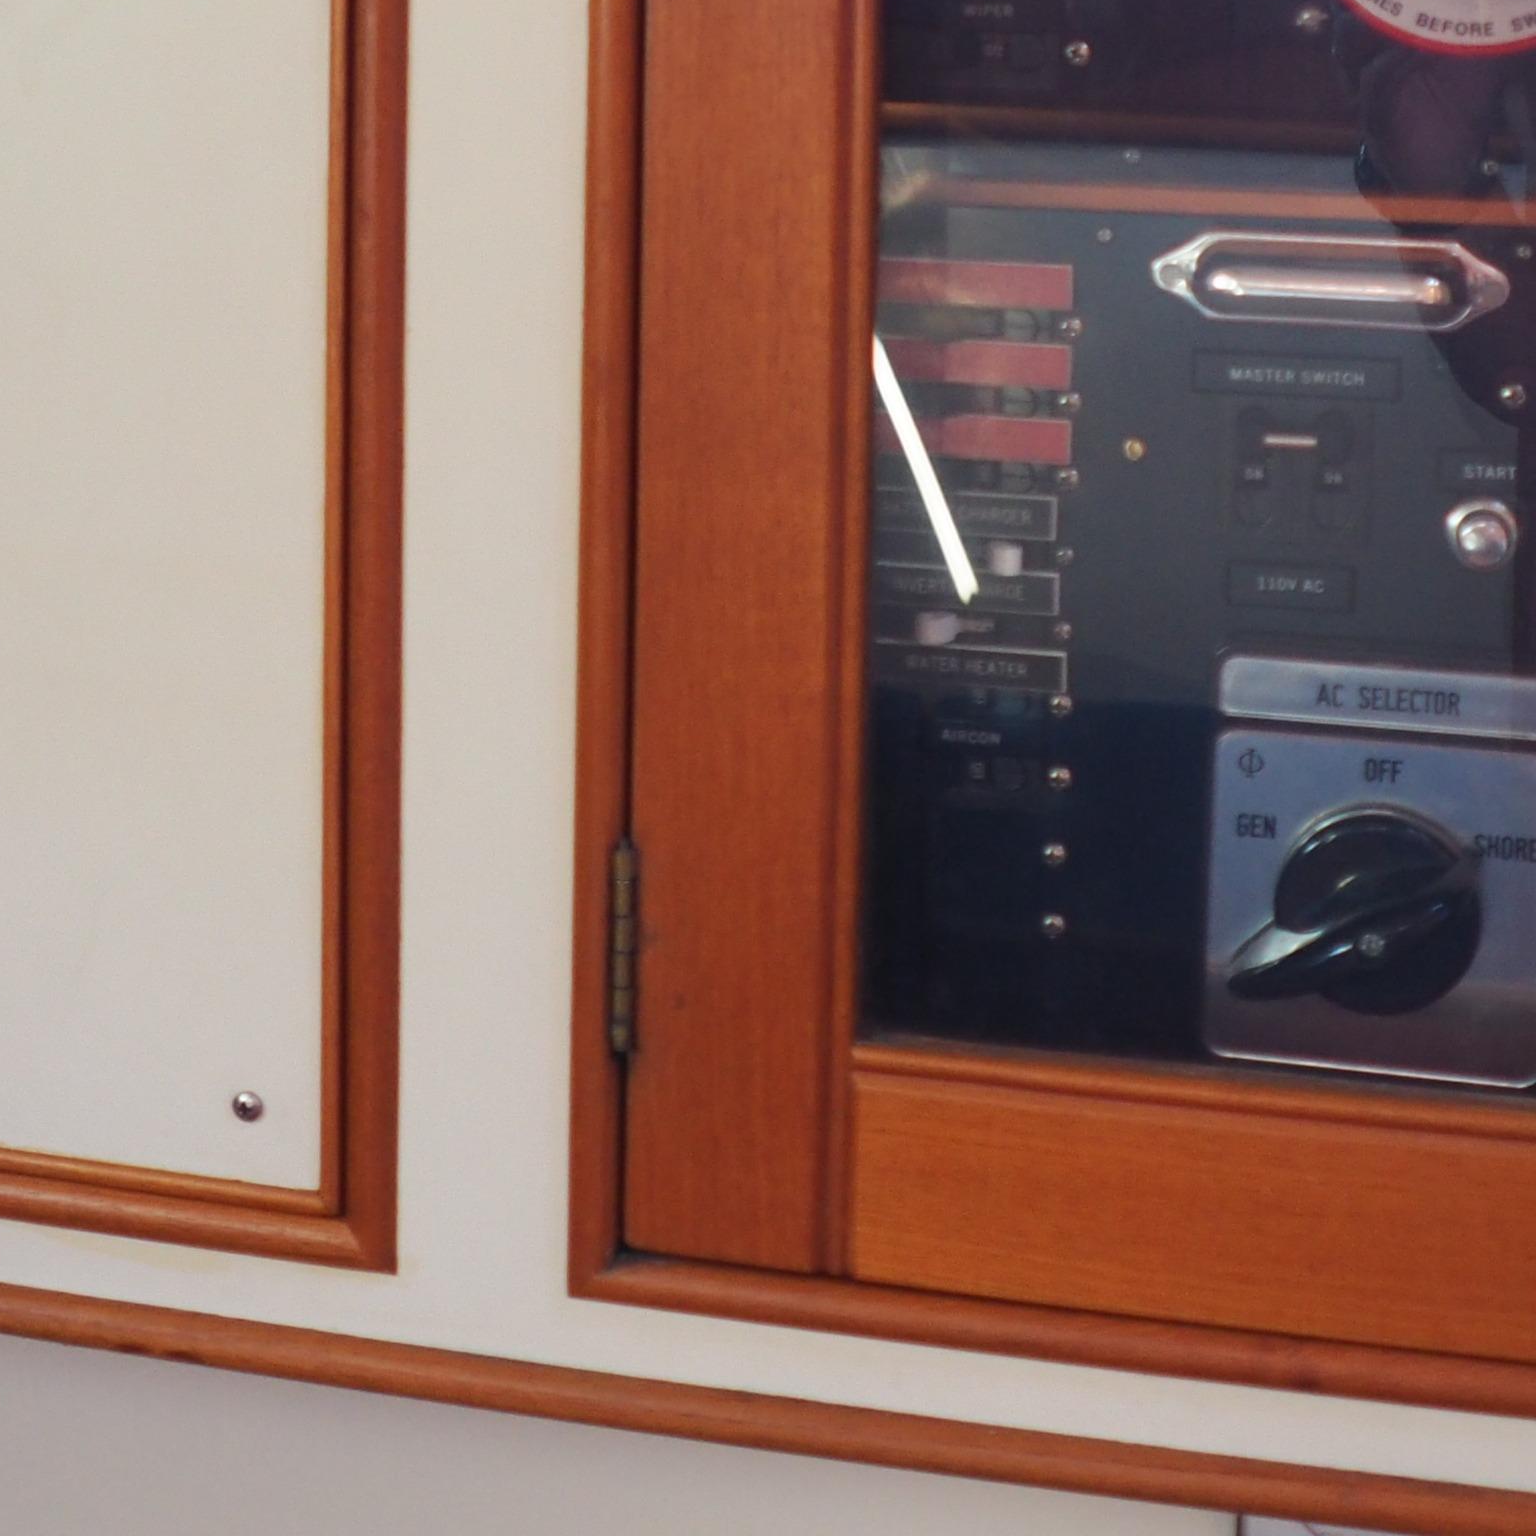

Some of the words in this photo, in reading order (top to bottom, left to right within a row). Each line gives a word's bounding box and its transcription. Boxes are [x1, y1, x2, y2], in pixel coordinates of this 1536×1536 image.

[1415, 11, 1495, 37] BEFORE
[1229, 367, 1295, 383] MASTER
[1301, 369, 1364, 386] SWITCH
[1464, 465, 1517, 481] START
[1303, 578, 1326, 594] AC
[1315, 683, 1343, 708] AC
[1358, 684, 1460, 716] SELECTOR
[1364, 757, 1404, 784] OFF
[1236, 813, 1278, 840] GEN
